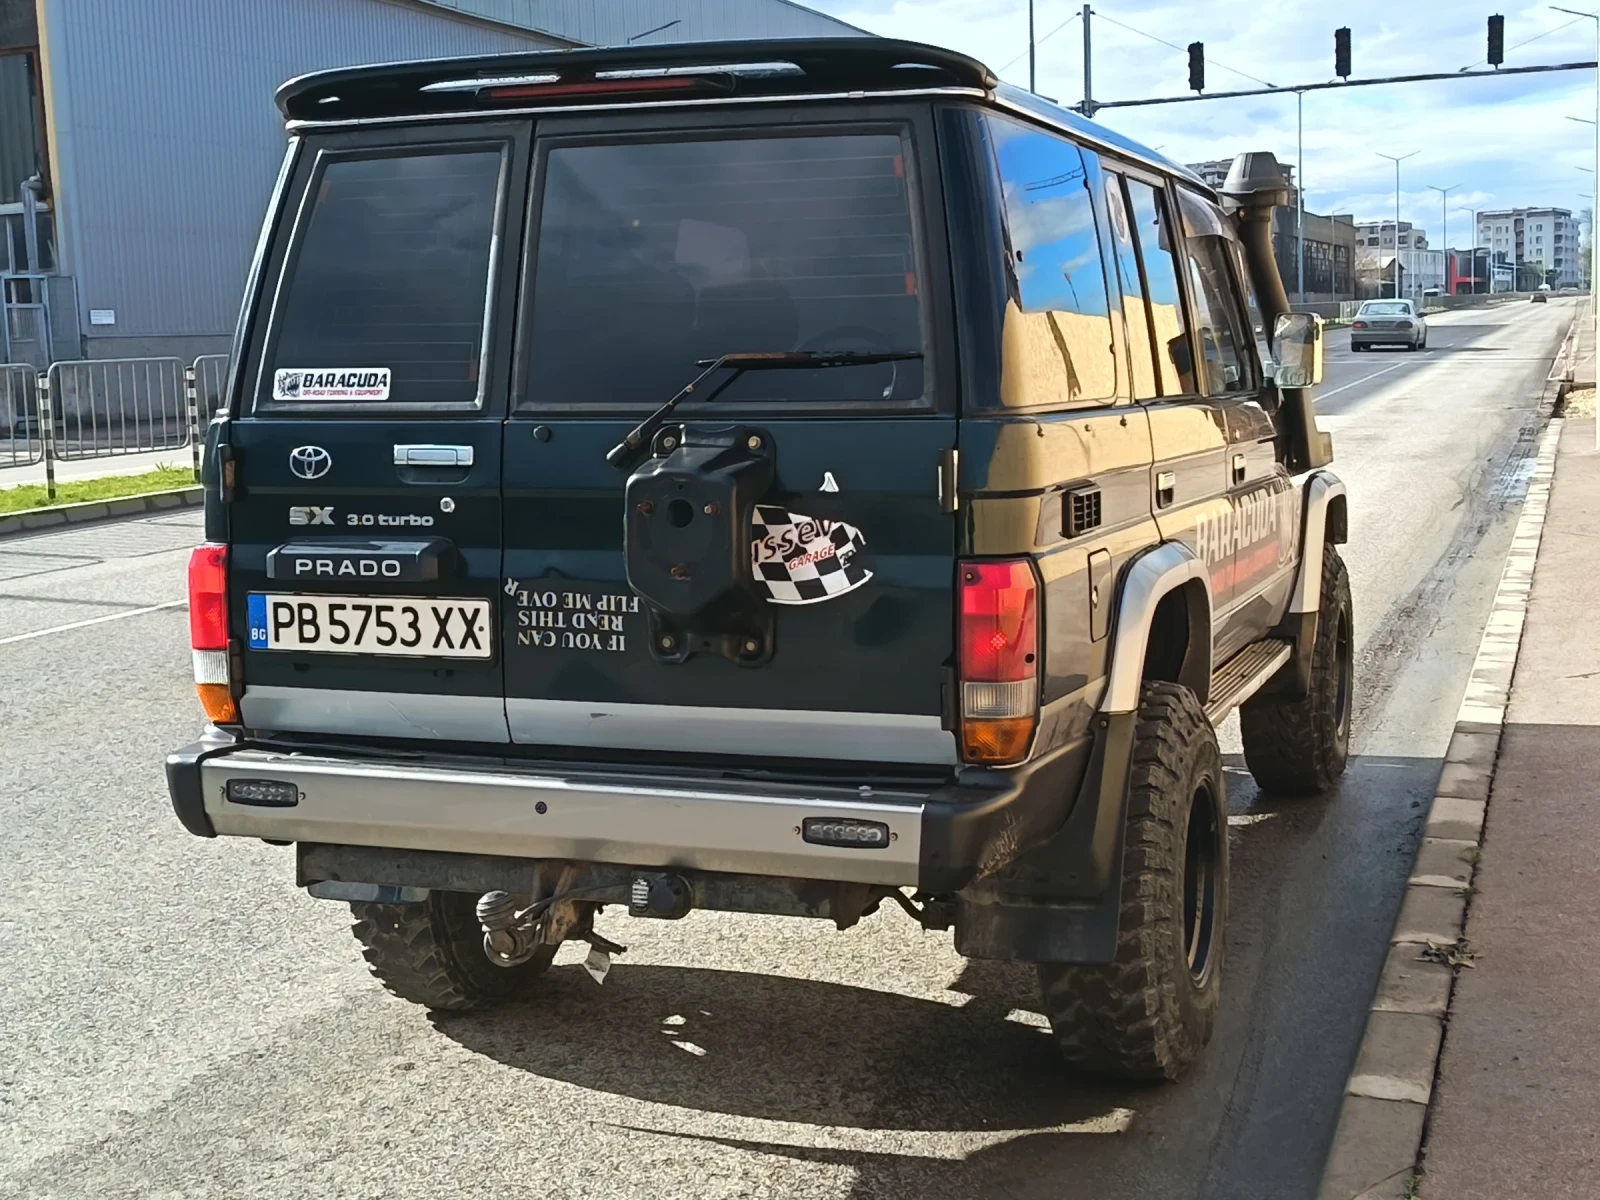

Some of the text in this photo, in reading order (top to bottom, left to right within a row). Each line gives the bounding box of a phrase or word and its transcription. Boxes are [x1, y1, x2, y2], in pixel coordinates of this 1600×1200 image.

[302, 373, 388, 388] BARACUDA
[289, 506, 434, 526] SX 3.0 turbo
[788, 543, 836, 571] GARAGE
[295, 559, 401, 577] PRADO
[504, 577, 639, 613] FLIP ME OVER
[272, 602, 482, 650] PB 5753 XX
[518, 610, 624, 631] READ THIS
[251, 628, 266, 640] BG
[517, 630, 626, 651] IF YOU CAN
